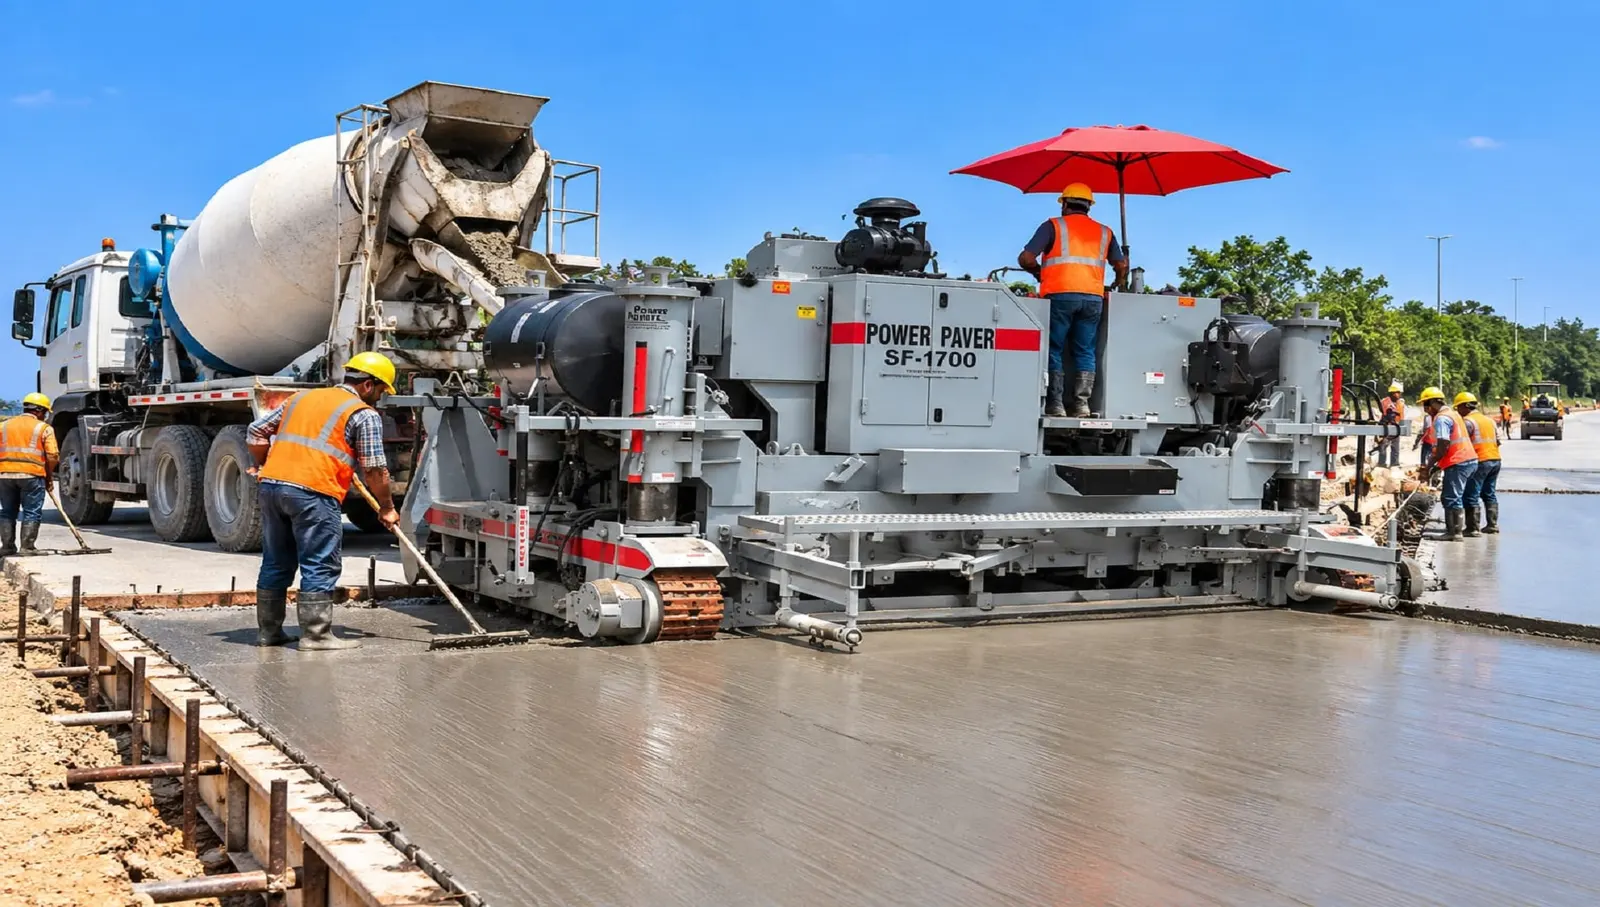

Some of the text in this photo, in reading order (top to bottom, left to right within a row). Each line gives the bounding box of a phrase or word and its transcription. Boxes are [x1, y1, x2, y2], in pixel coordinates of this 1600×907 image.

[866, 323, 994, 350] POWER PAVER
[884, 349, 977, 368] SF-1700
